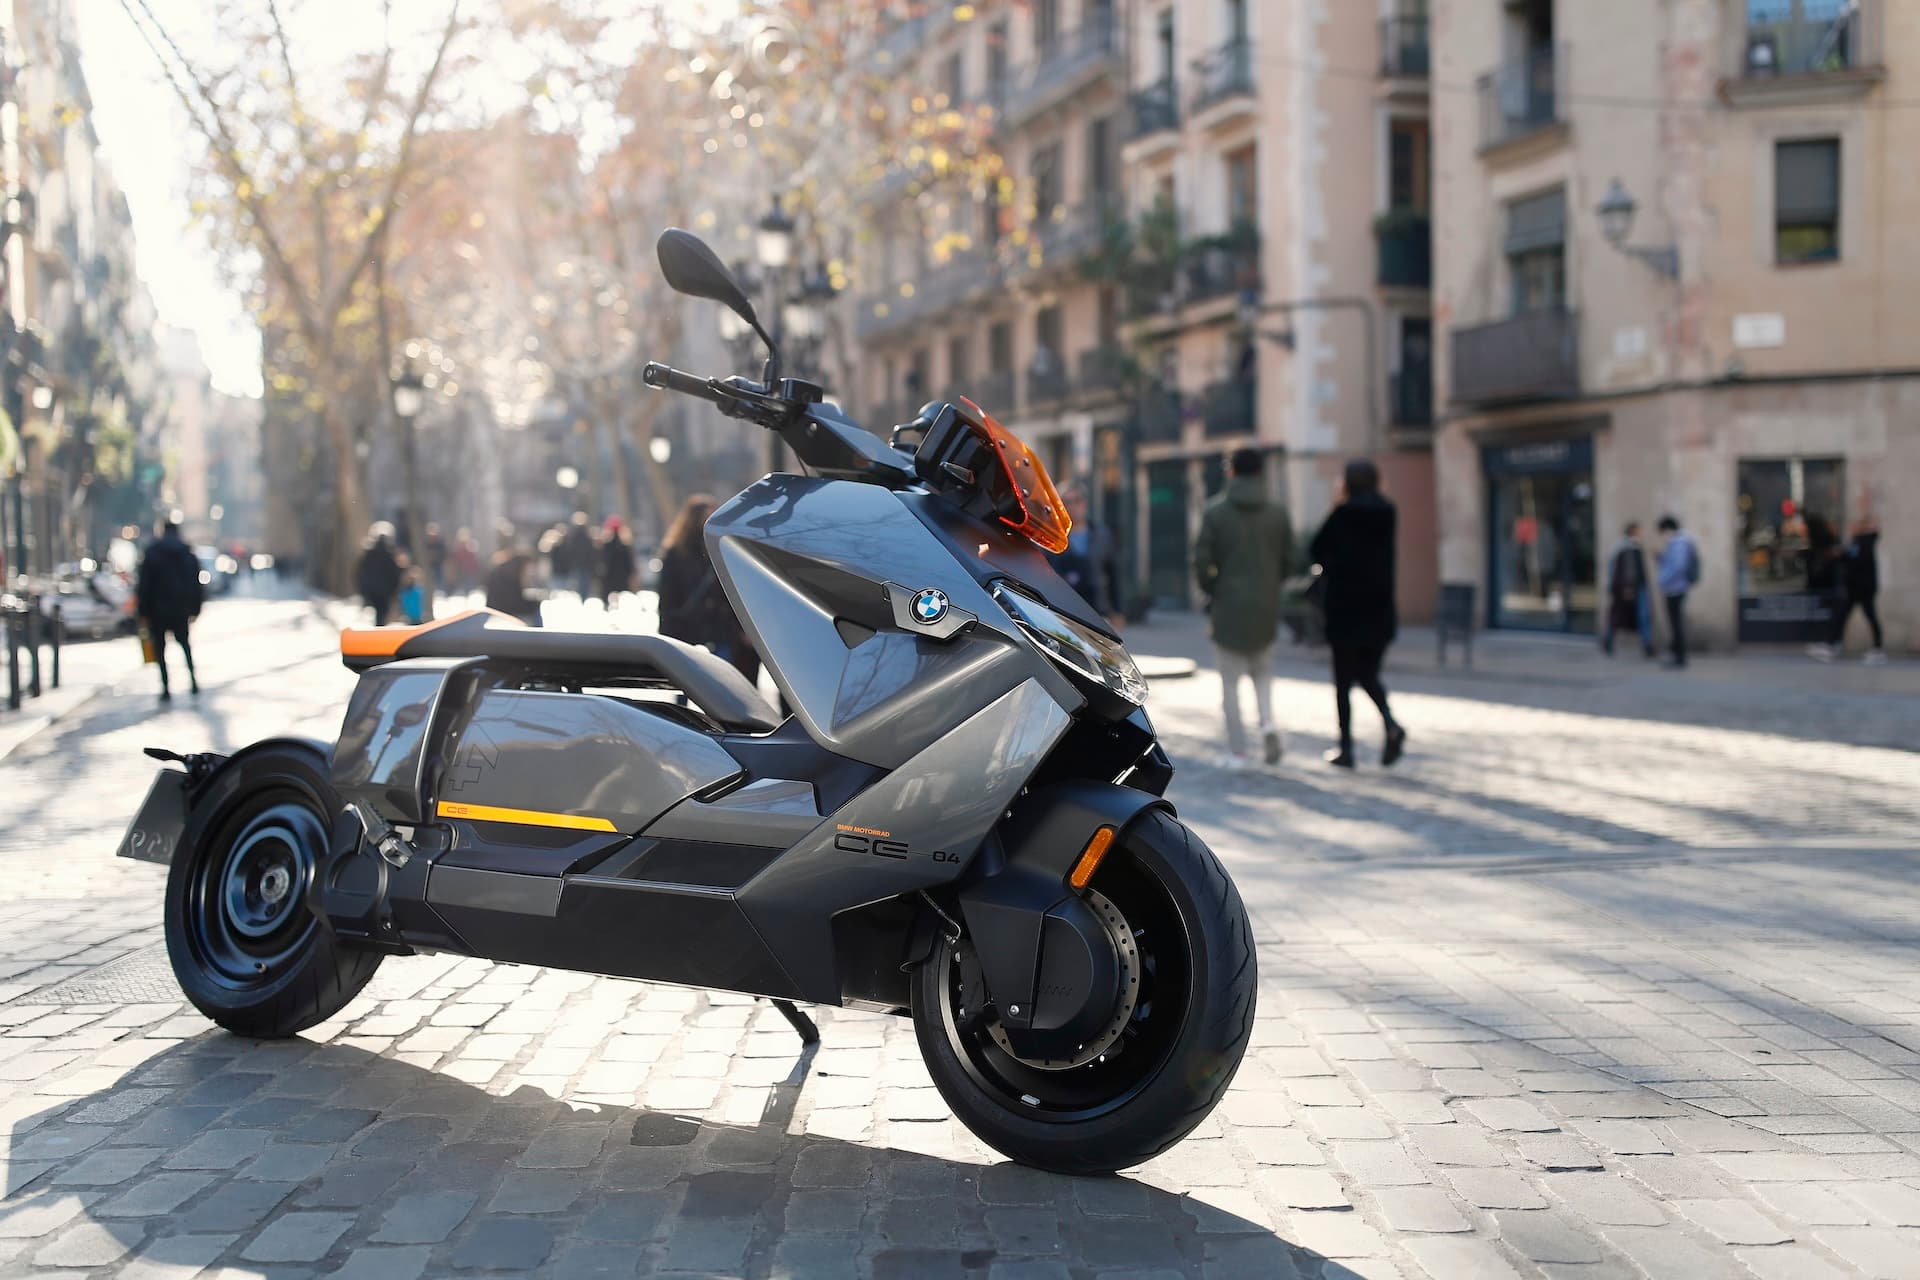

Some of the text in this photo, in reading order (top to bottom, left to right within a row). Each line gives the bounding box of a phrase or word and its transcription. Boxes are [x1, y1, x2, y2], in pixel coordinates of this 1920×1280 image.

[920, 591, 948, 605] BMW
[853, 827, 890, 837] MOTORRAD
[834, 834, 960, 864] CE 04
